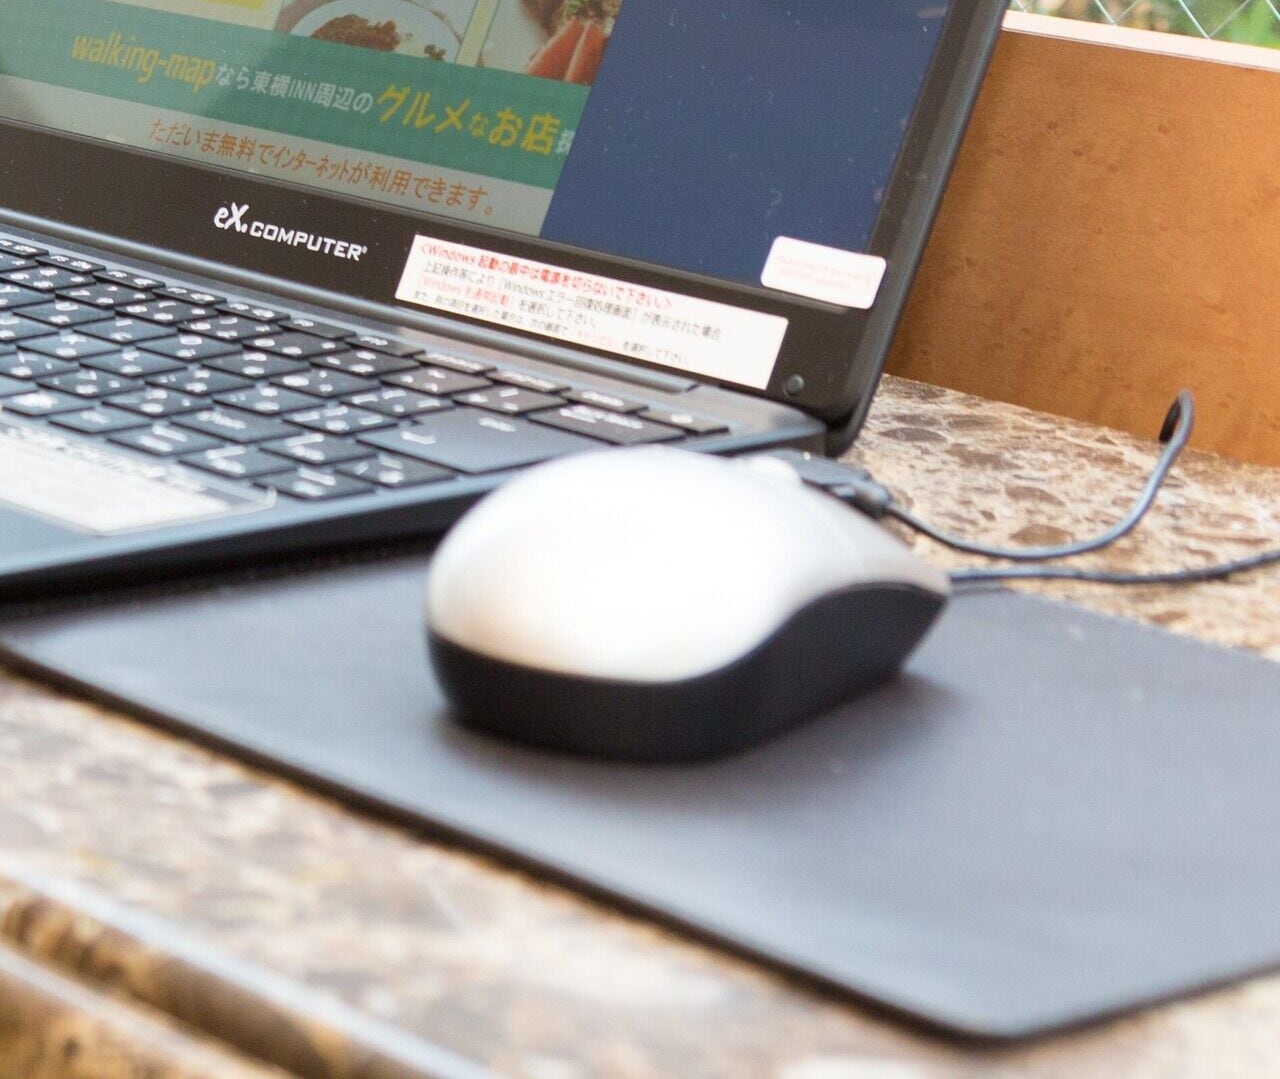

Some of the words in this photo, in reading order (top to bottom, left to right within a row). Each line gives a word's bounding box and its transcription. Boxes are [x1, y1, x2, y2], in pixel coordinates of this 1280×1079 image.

[147, 118, 493, 216] ただいま無料でインターネットが利用できます。
